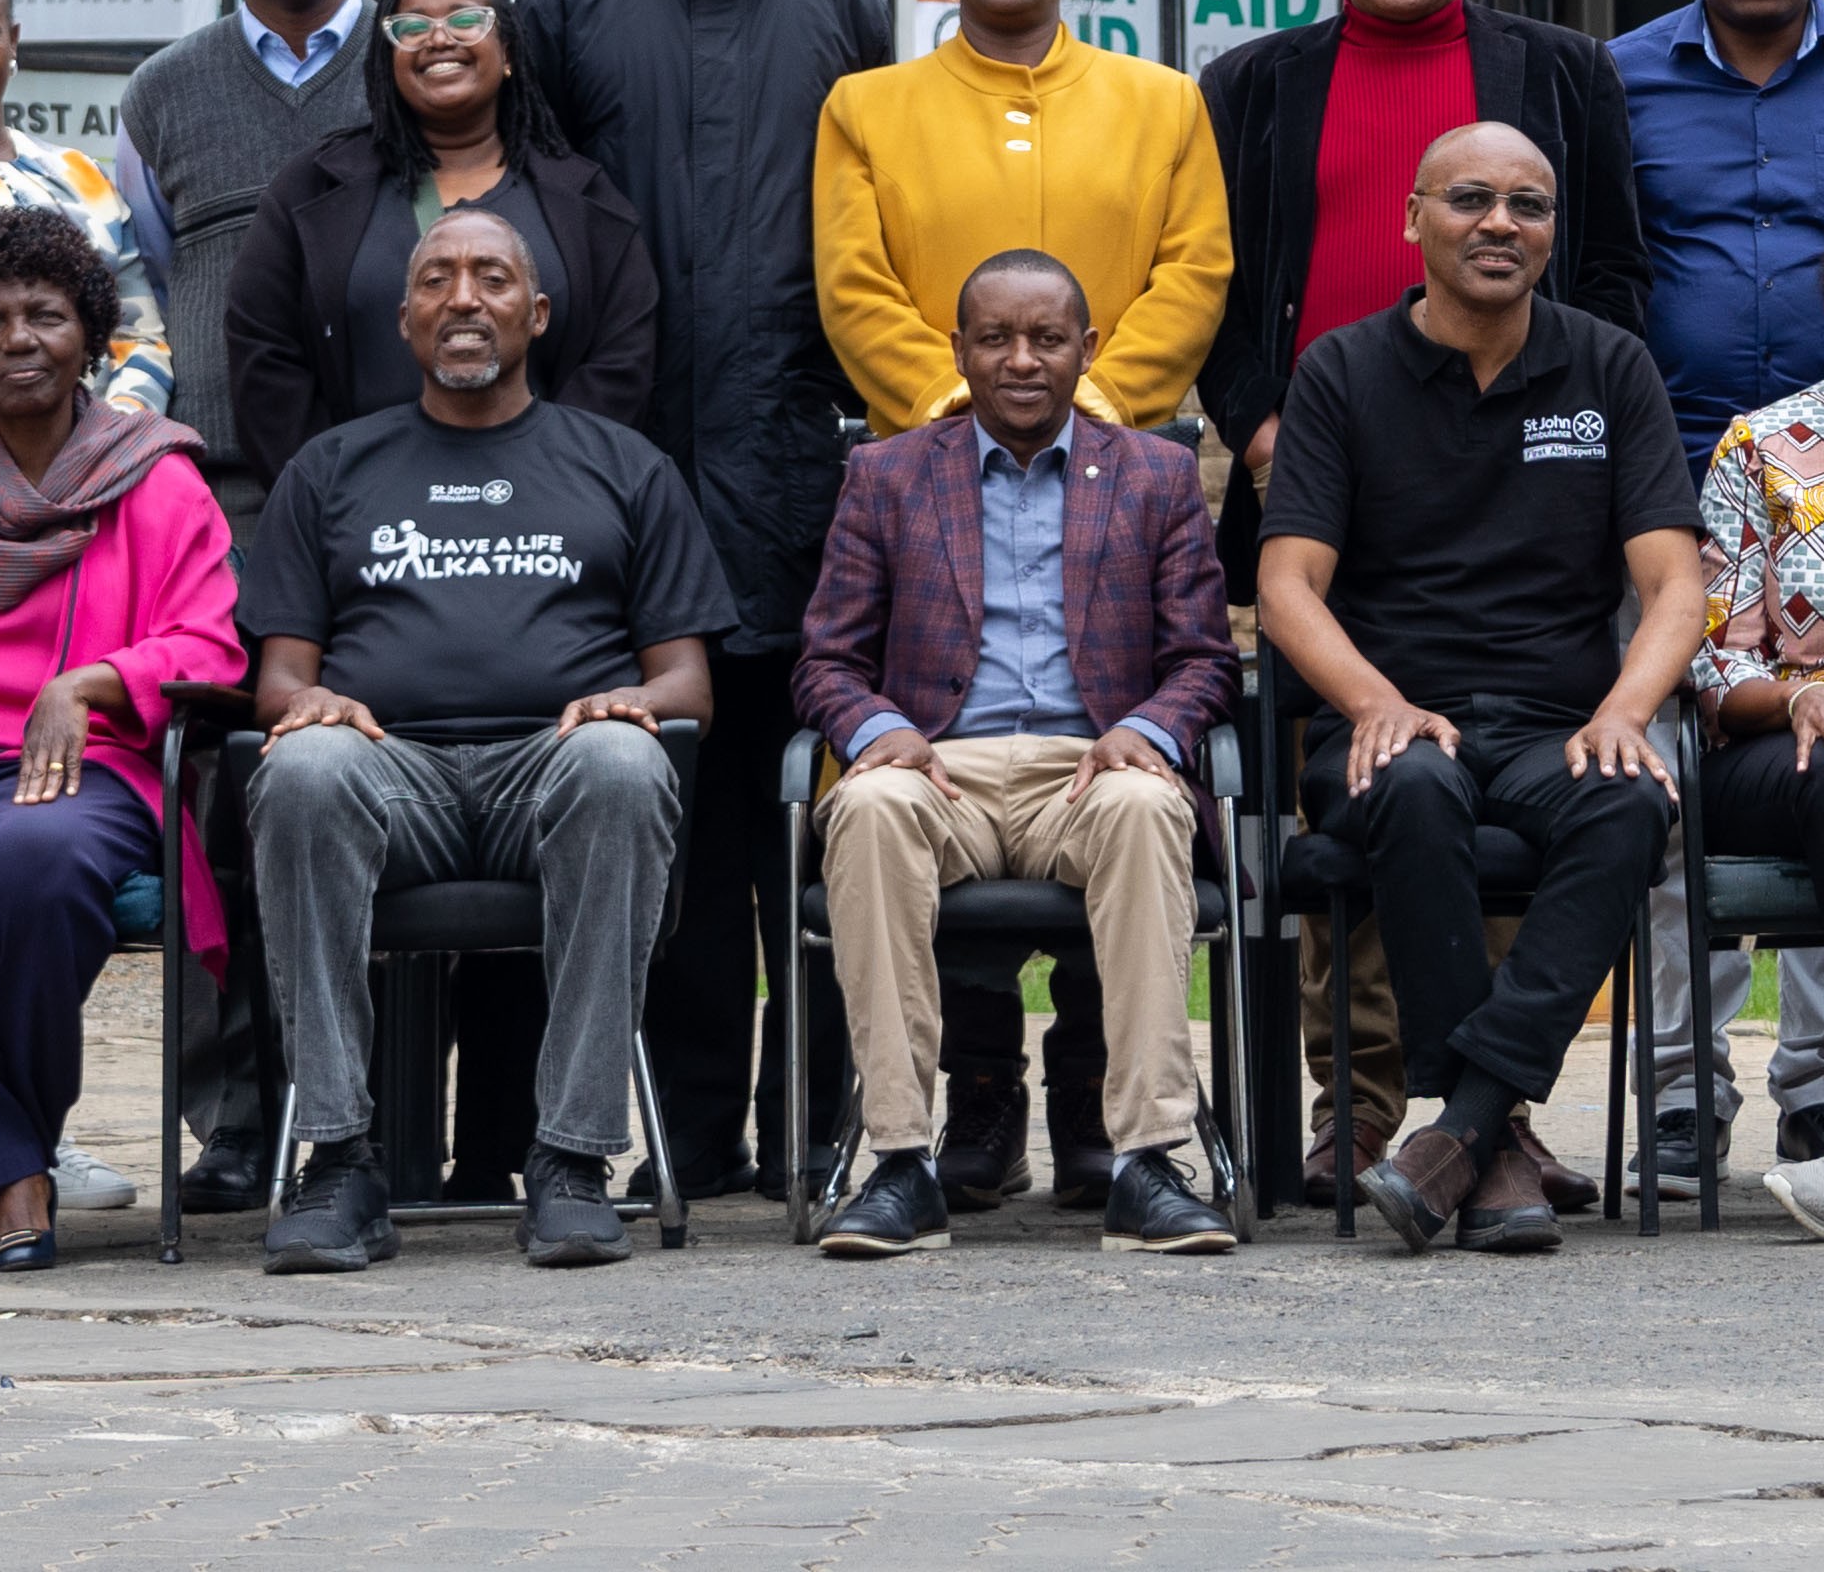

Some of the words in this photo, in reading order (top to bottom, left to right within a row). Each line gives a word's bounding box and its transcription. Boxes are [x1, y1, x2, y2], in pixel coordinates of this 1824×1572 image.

[3, 101, 72, 135] RST
[81, 104, 119, 136] AI
[1523, 417, 1538, 433] St
[1539, 414, 1571, 430] John
[1524, 429, 1572, 442] Ambulance
[429, 484, 446, 496] St
[447, 484, 480, 496] John
[428, 494, 480, 503] Ambulance
[429, 538, 490, 555] SAVE
[493, 537, 512, 552] A
[516, 534, 564, 553] LIFE
